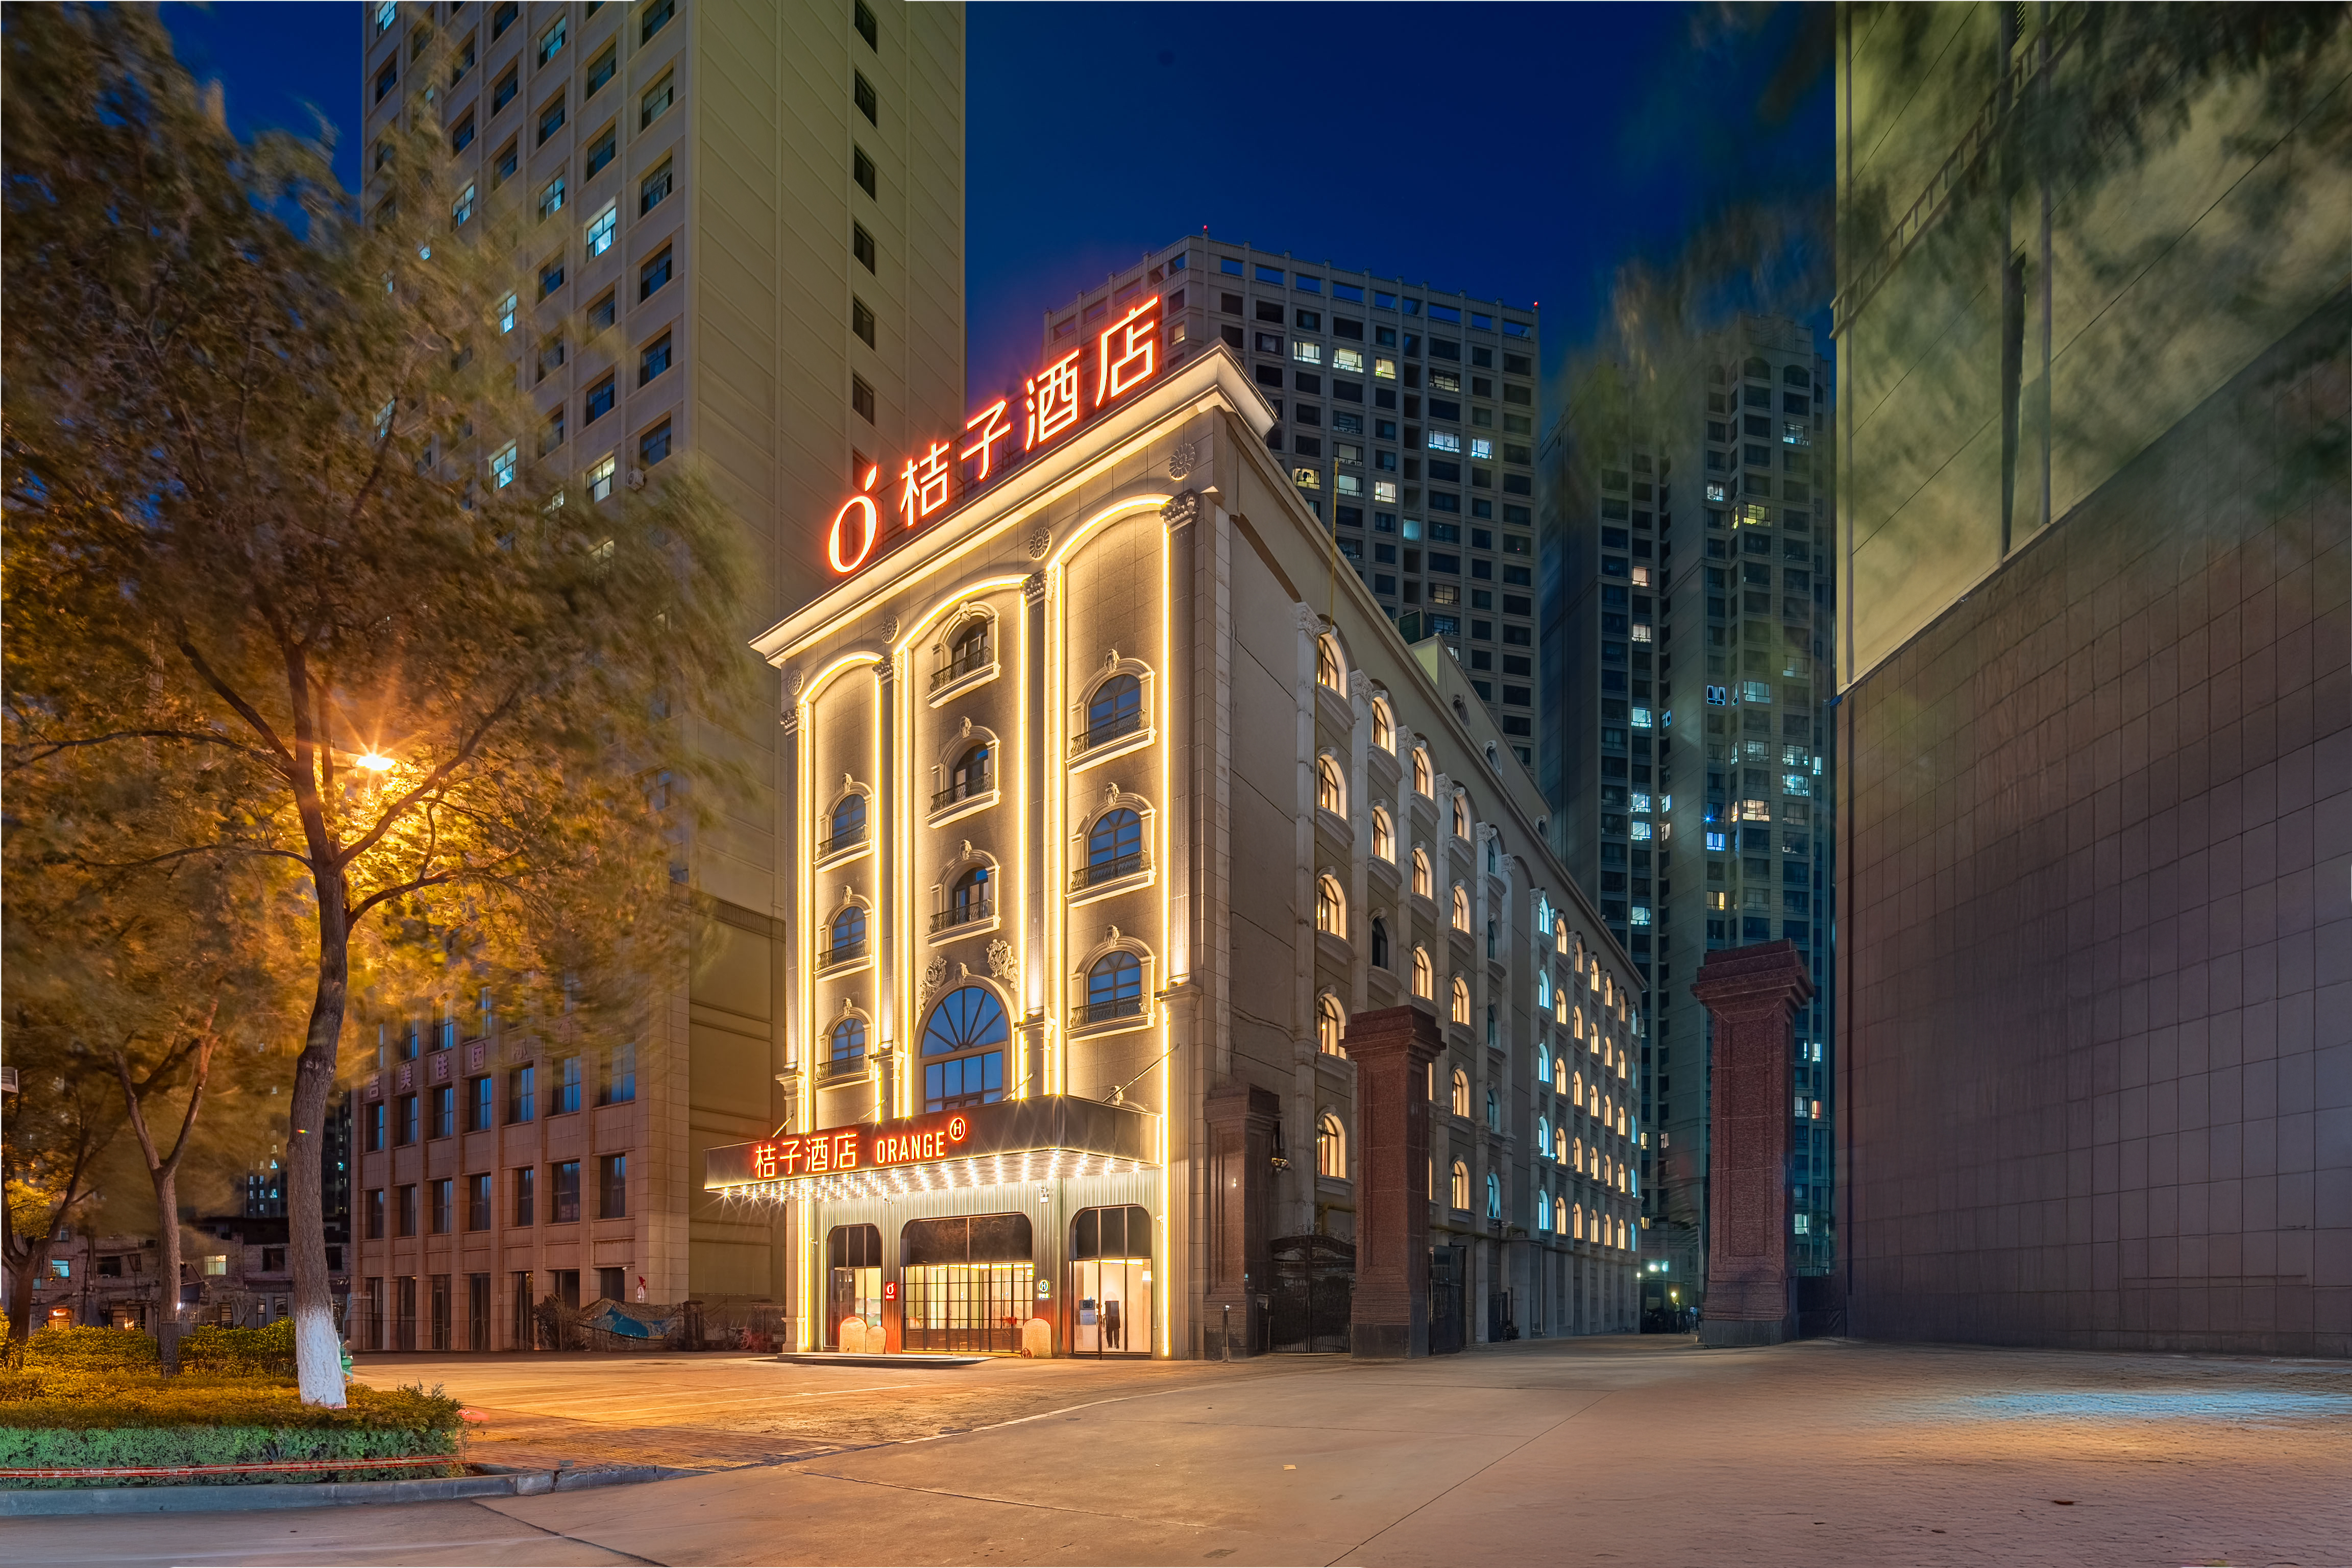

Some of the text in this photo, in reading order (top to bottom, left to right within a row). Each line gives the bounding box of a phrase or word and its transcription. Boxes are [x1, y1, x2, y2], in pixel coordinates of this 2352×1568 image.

[900, 296, 1159, 527] 桔子酒店
[755, 1133, 857, 1178] 桔子酒店
[876, 1131, 945, 1164] ORANGE
